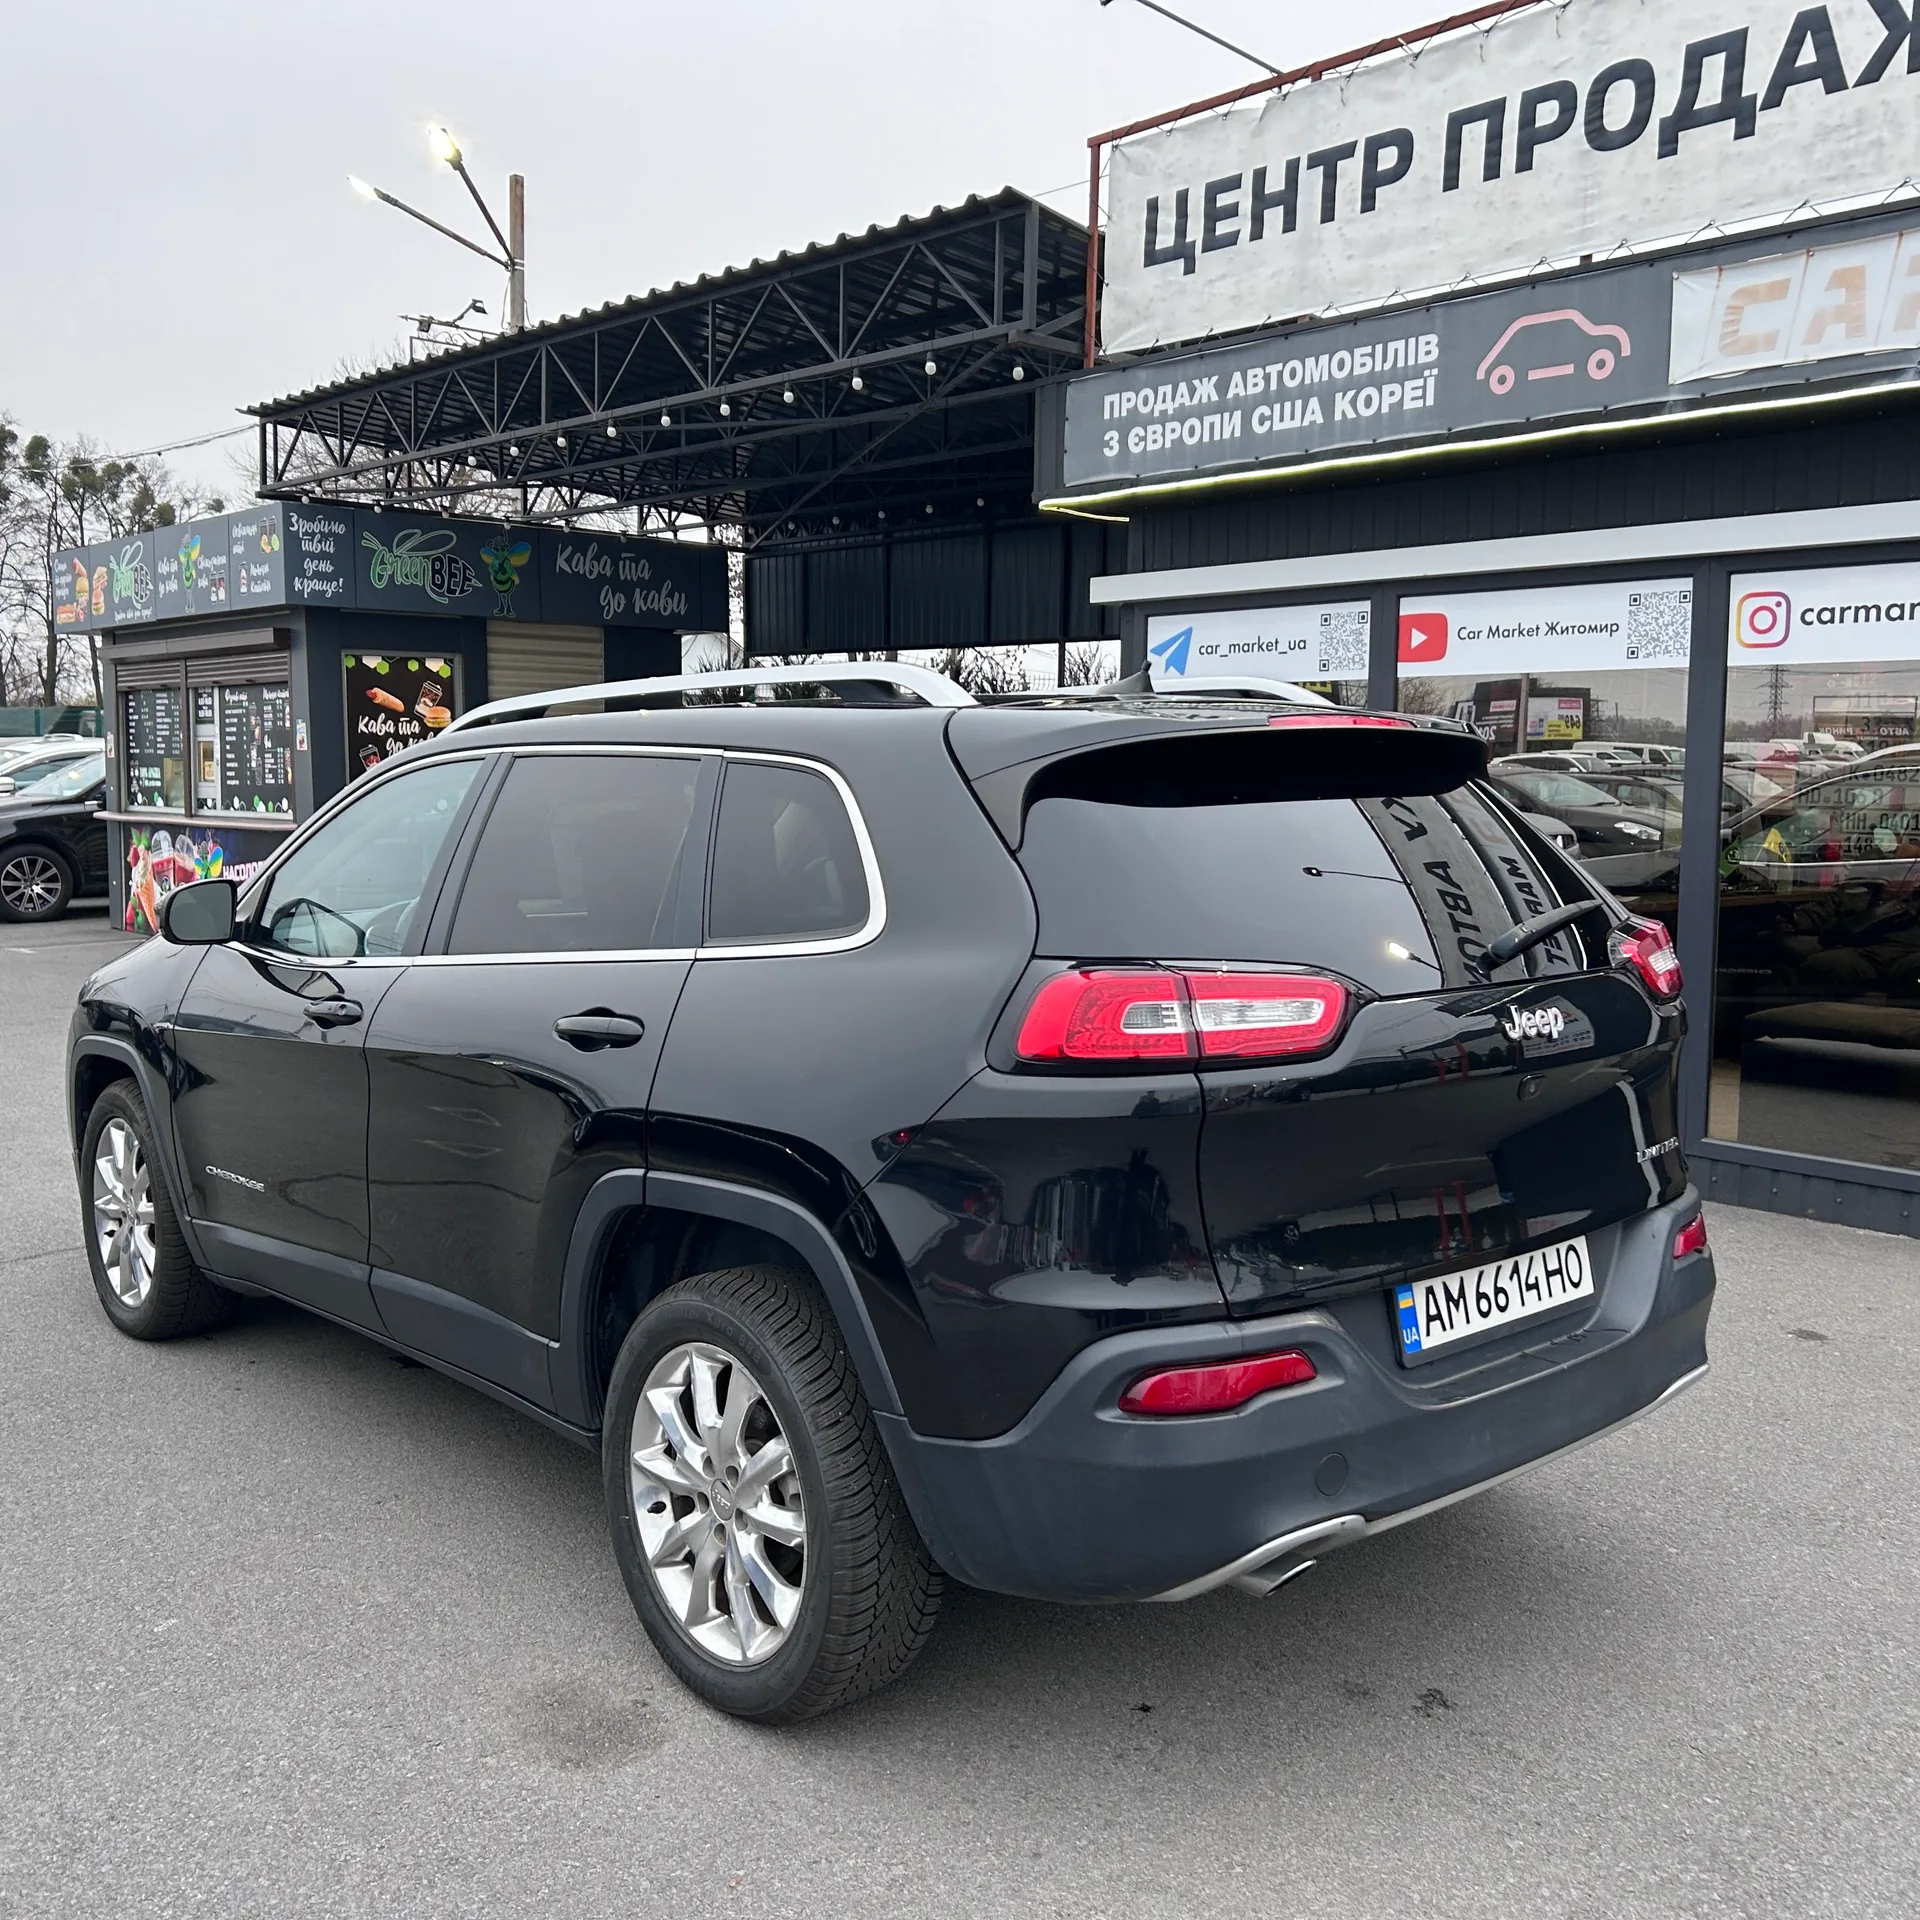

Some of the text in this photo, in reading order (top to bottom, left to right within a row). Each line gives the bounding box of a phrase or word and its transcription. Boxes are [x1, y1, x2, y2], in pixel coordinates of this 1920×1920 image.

[1143, 127, 1414, 276] ЦЕНТР
[1103, 333, 1439, 420] ПРОДАЖ АВТОМОБІЛІВ
[1103, 368, 1439, 457] З ЄВРОПИ США КОРЕЇ
[289, 512, 346, 538] Зробимо
[303, 558, 334, 576] день
[556, 541, 652, 582] Кава та
[293, 577, 344, 598] краще!
[600, 580, 688, 620] до кави
[1457, 621, 1620, 641] Car Market Житомир
[1198, 635, 1307, 658] car_market_ua
[358, 713, 421, 736] Кава та
[1504, 1003, 1565, 1041] Jeep
[205, 1165, 265, 1192] CHEROKEE
[1403, 1328, 1419, 1344] UA
